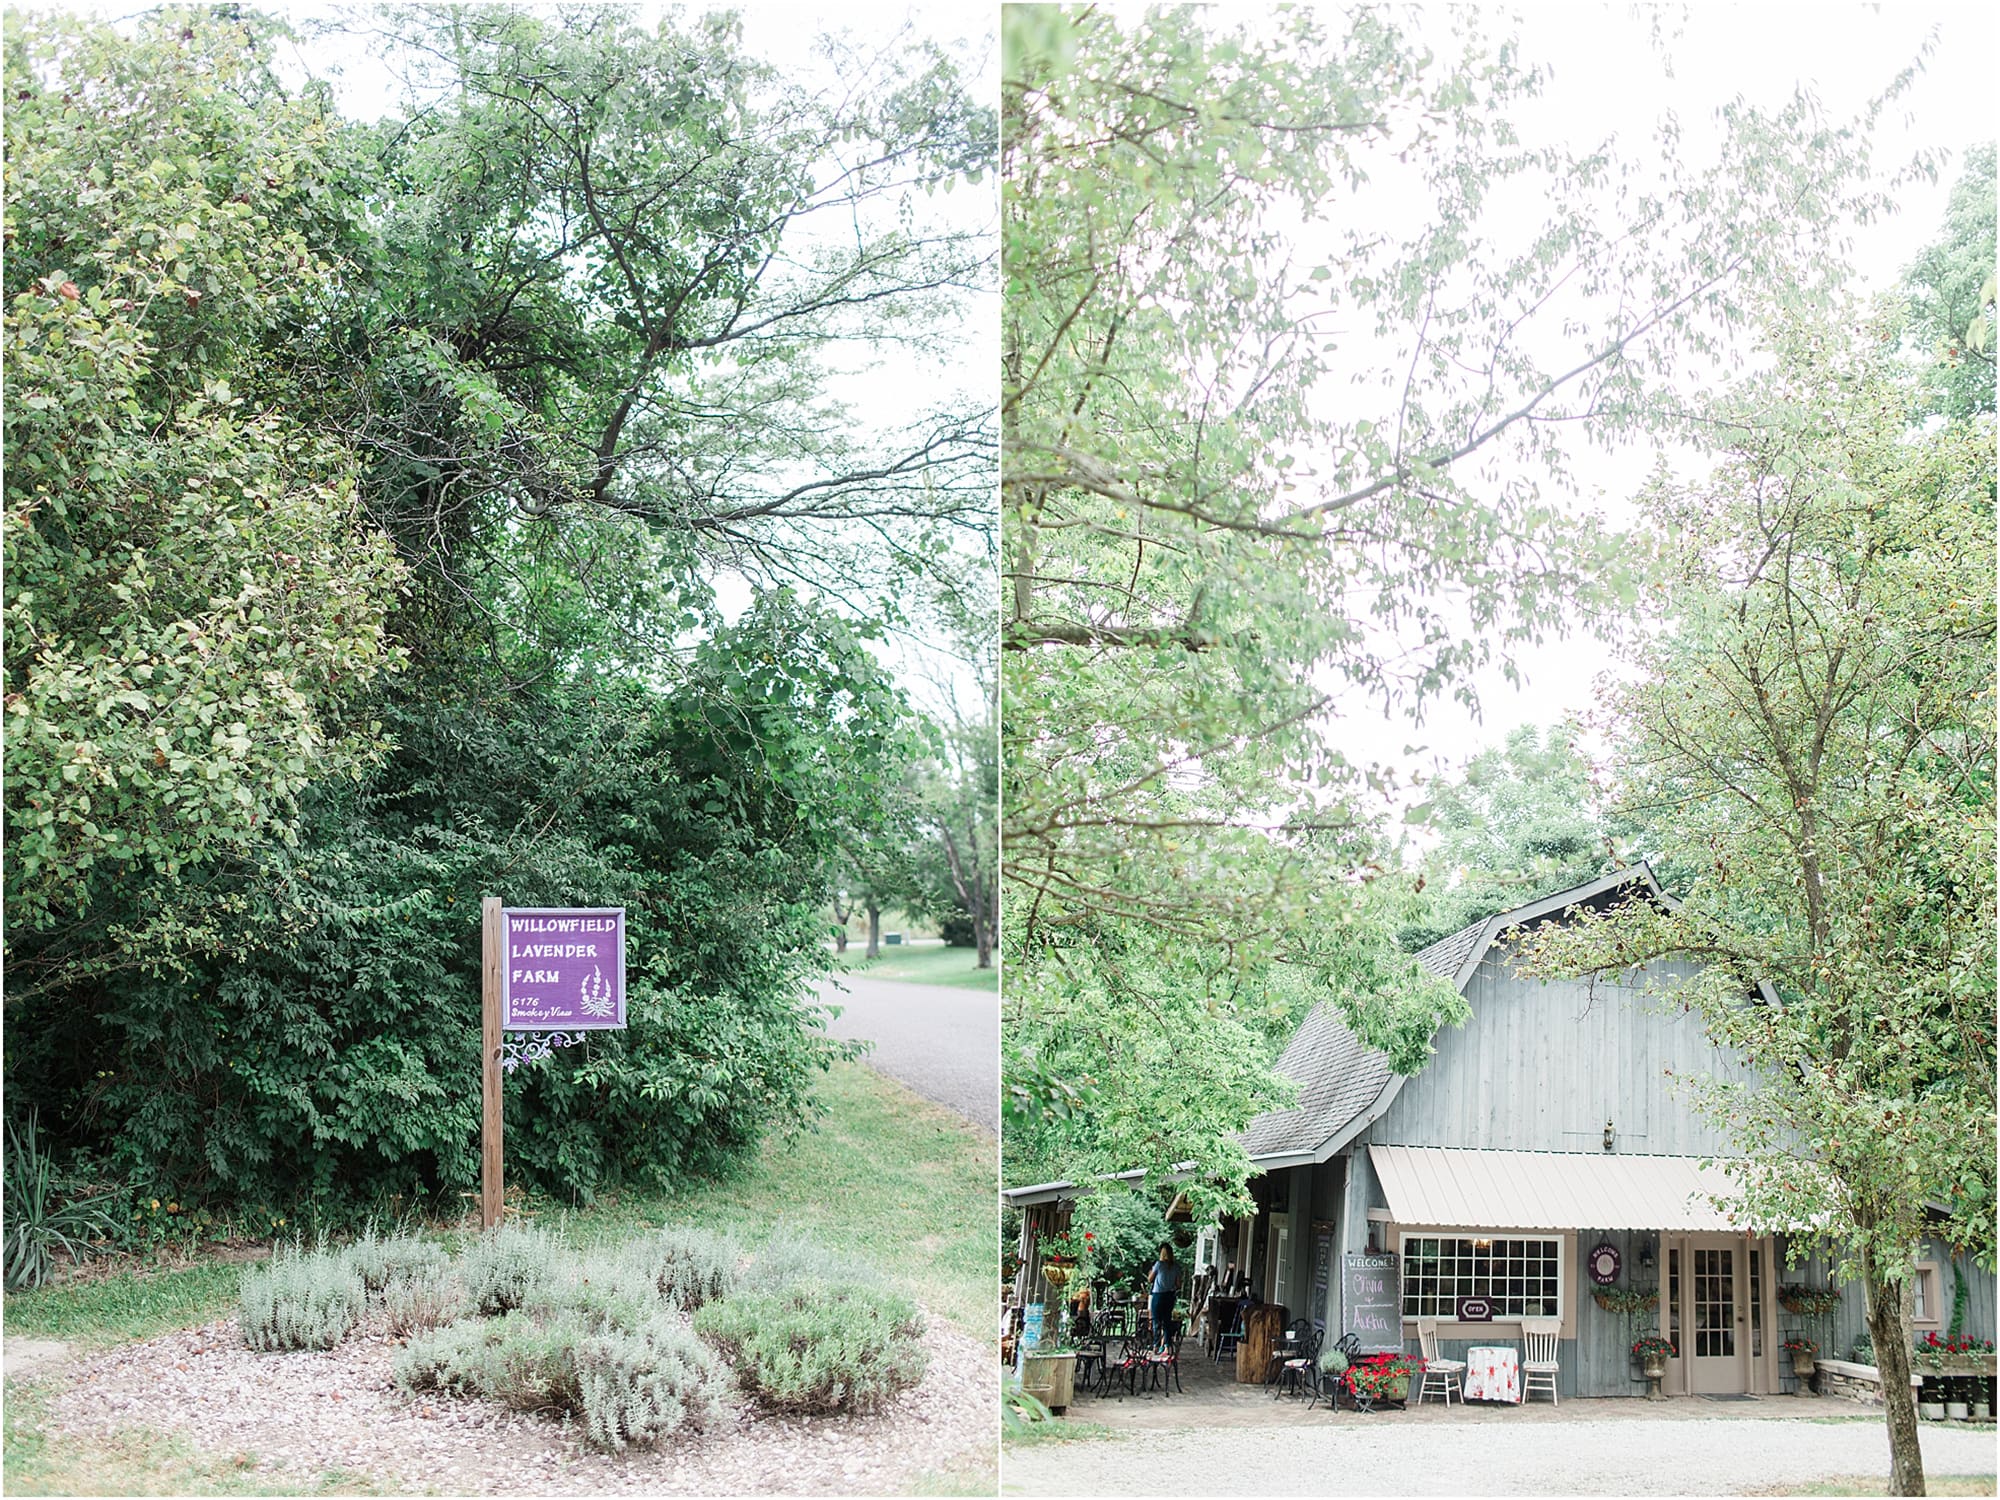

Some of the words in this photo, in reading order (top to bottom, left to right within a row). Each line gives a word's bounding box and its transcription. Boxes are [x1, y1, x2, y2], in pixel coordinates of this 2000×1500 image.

[511, 919, 616, 932] WILLOWFIELD
[512, 944, 598, 958] LAVENDER
[512, 970, 560, 983] FARM
[512, 997, 540, 1006] 6176
[511, 1007, 551, 1020] Smokey
[550, 1007, 573, 1017] View
[1353, 1274, 1385, 1295] Olivia
[1467, 1305, 1484, 1313] OPEN
[1353, 1307, 1391, 1331] Austin
